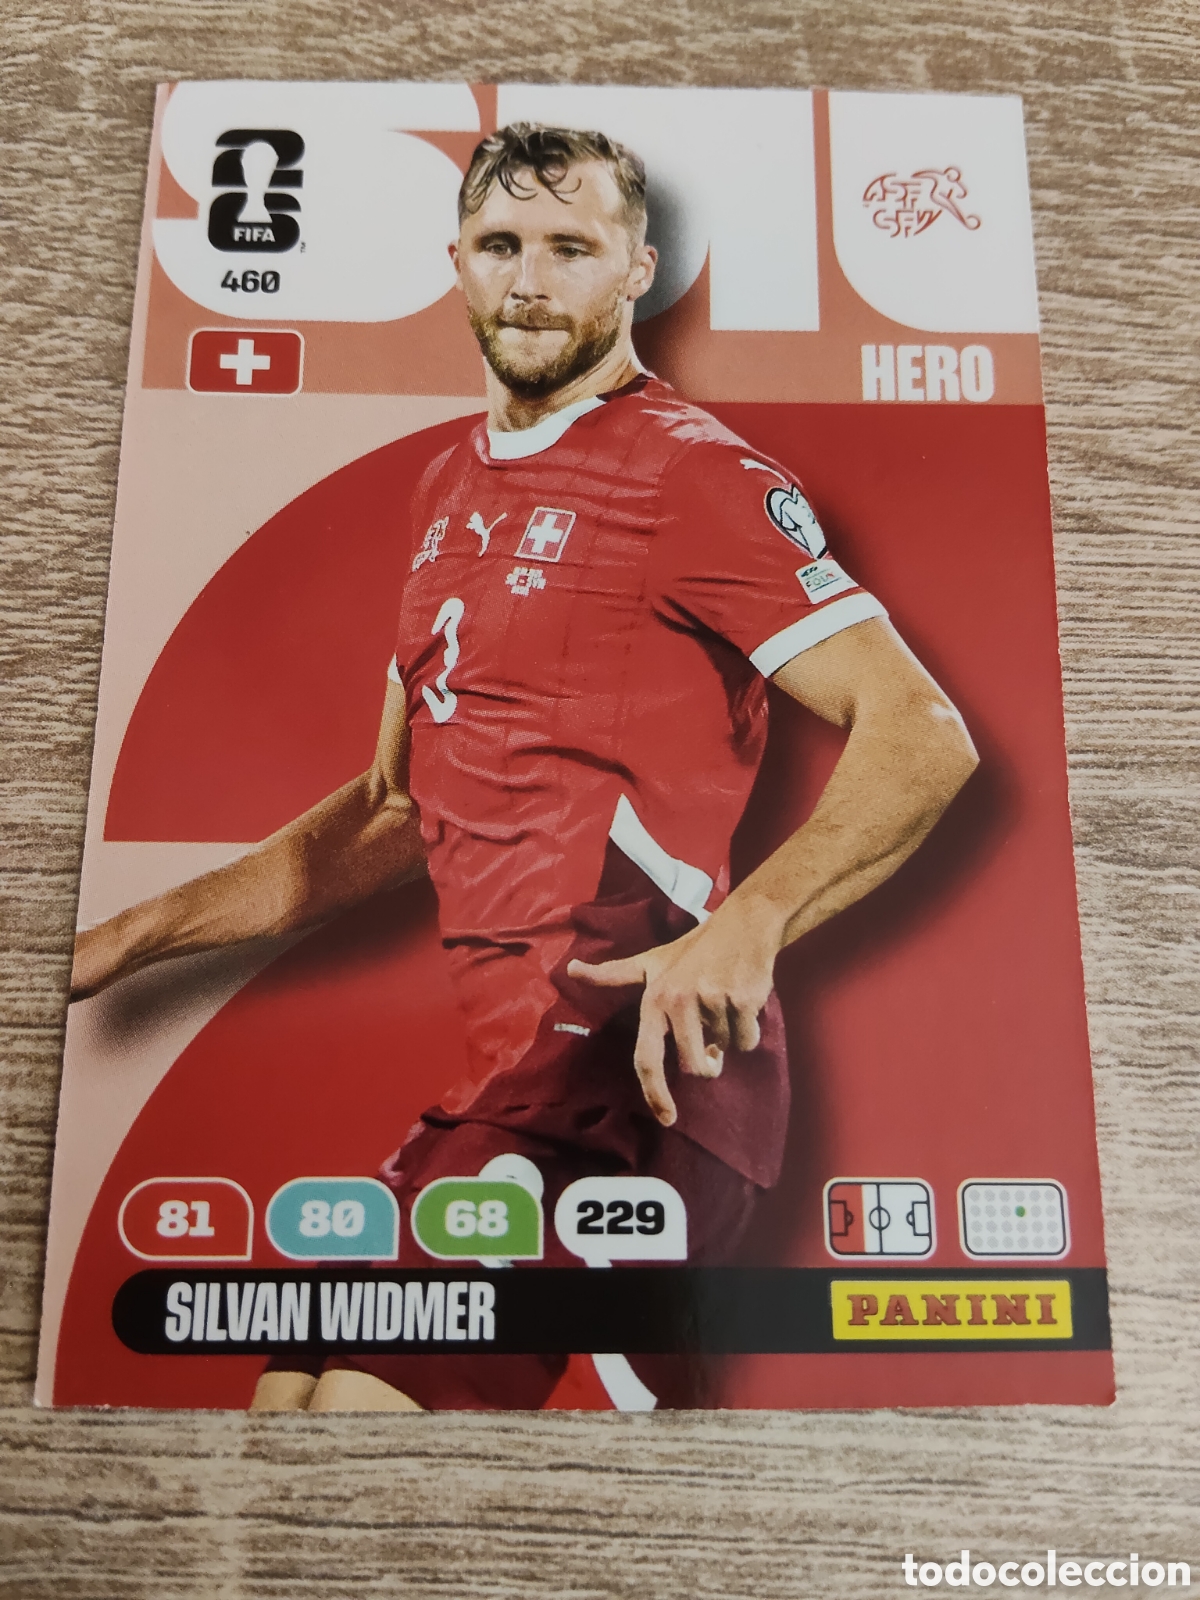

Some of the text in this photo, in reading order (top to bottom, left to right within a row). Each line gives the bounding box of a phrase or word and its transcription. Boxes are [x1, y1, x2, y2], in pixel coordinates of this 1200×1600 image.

[233, 226, 276, 243] FIFA
[220, 269, 281, 294] 460
[861, 344, 995, 403] HERO
[157, 1200, 215, 1238] 81
[300, 1200, 366, 1238] 80
[444, 1200, 510, 1238] 68
[576, 1200, 665, 1236] 229
[164, 1281, 496, 1342] SILVAN WIDMER
[847, 1294, 1058, 1326] PANINI
